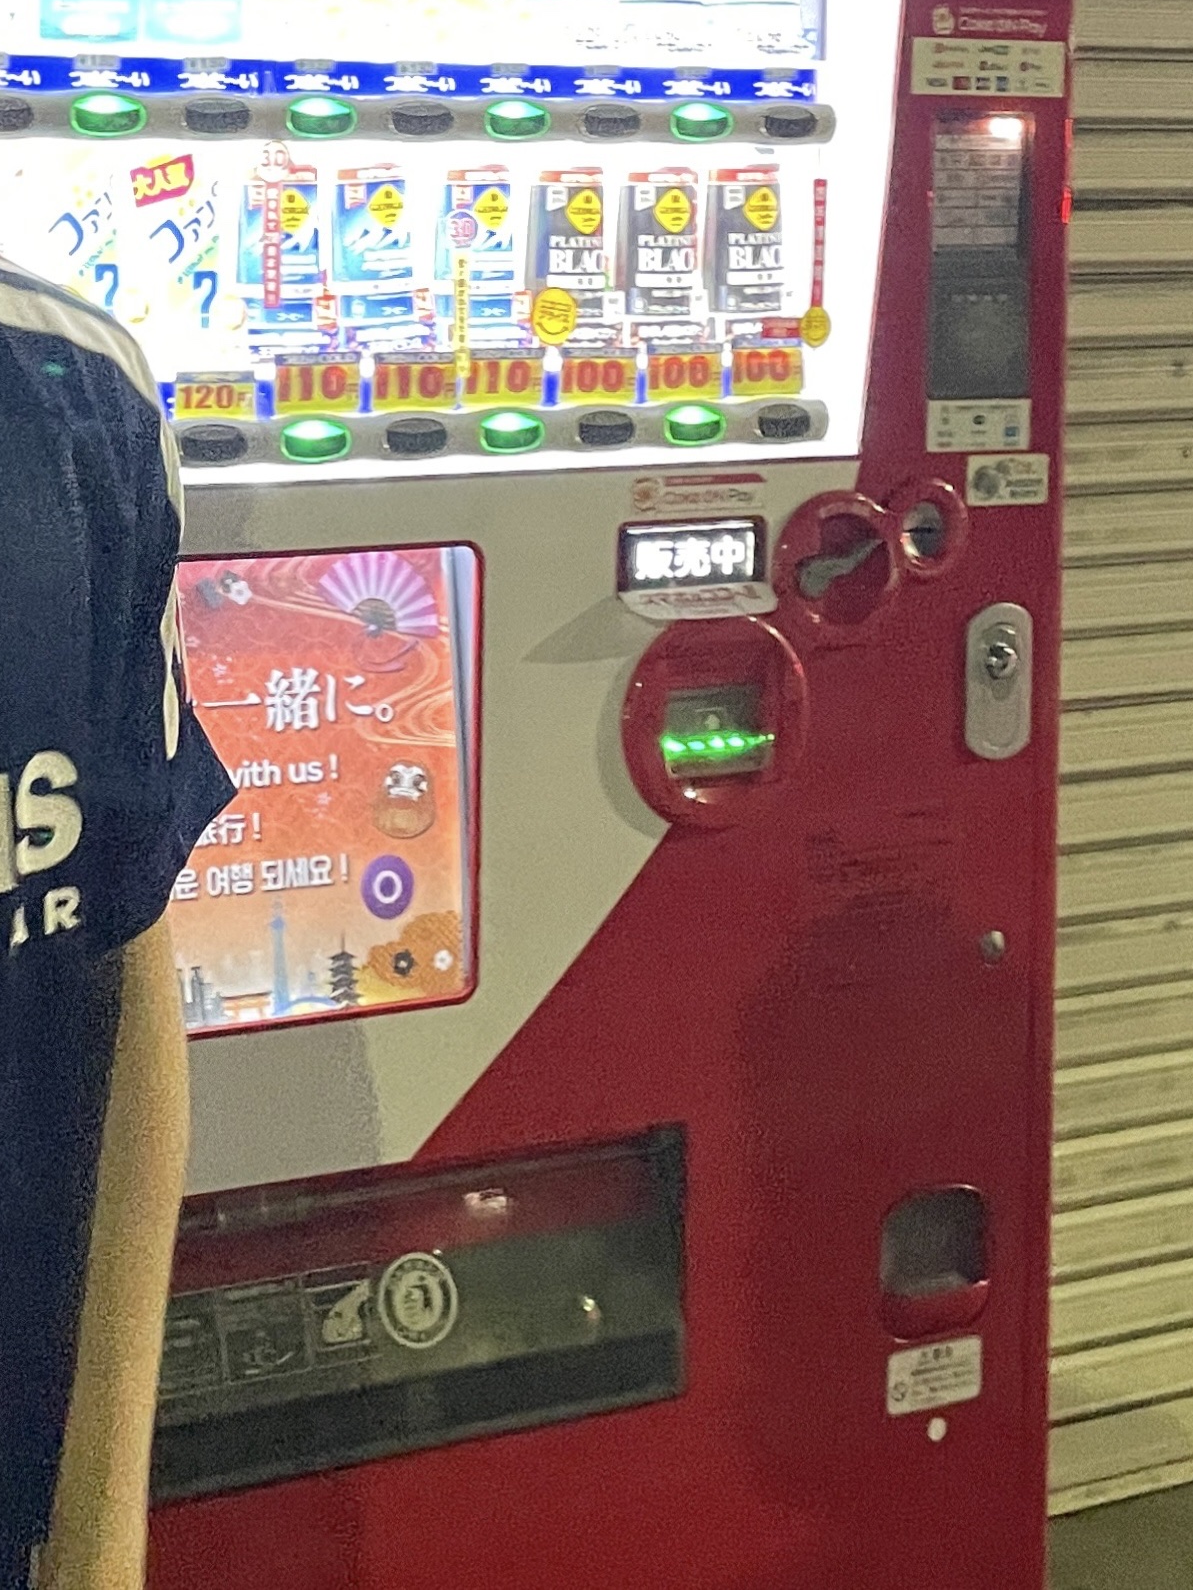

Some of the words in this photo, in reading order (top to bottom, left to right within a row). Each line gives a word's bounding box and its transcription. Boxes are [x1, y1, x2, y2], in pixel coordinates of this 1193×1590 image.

[635, 534, 746, 580] 販売中
[207, 862, 255, 897] 여행
